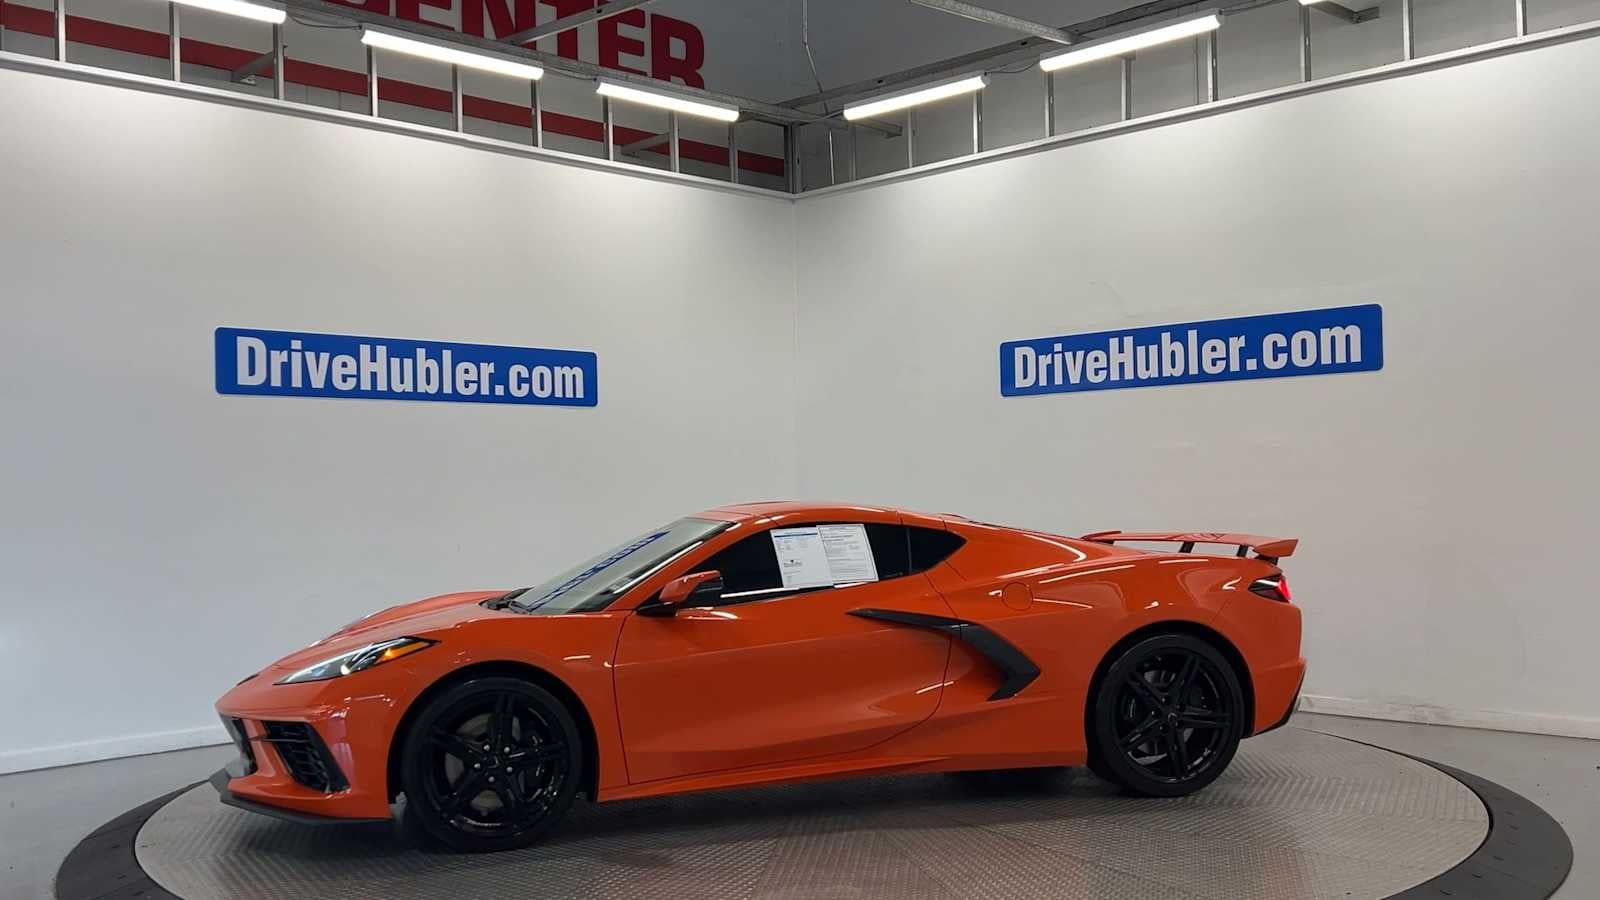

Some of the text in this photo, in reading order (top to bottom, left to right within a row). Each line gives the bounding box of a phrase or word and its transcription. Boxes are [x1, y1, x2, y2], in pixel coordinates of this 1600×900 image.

[326, 0, 705, 90] NTER
[236, 335, 585, 400] DriveHubler.com
[1014, 324, 1362, 389] DriveHubler.com
